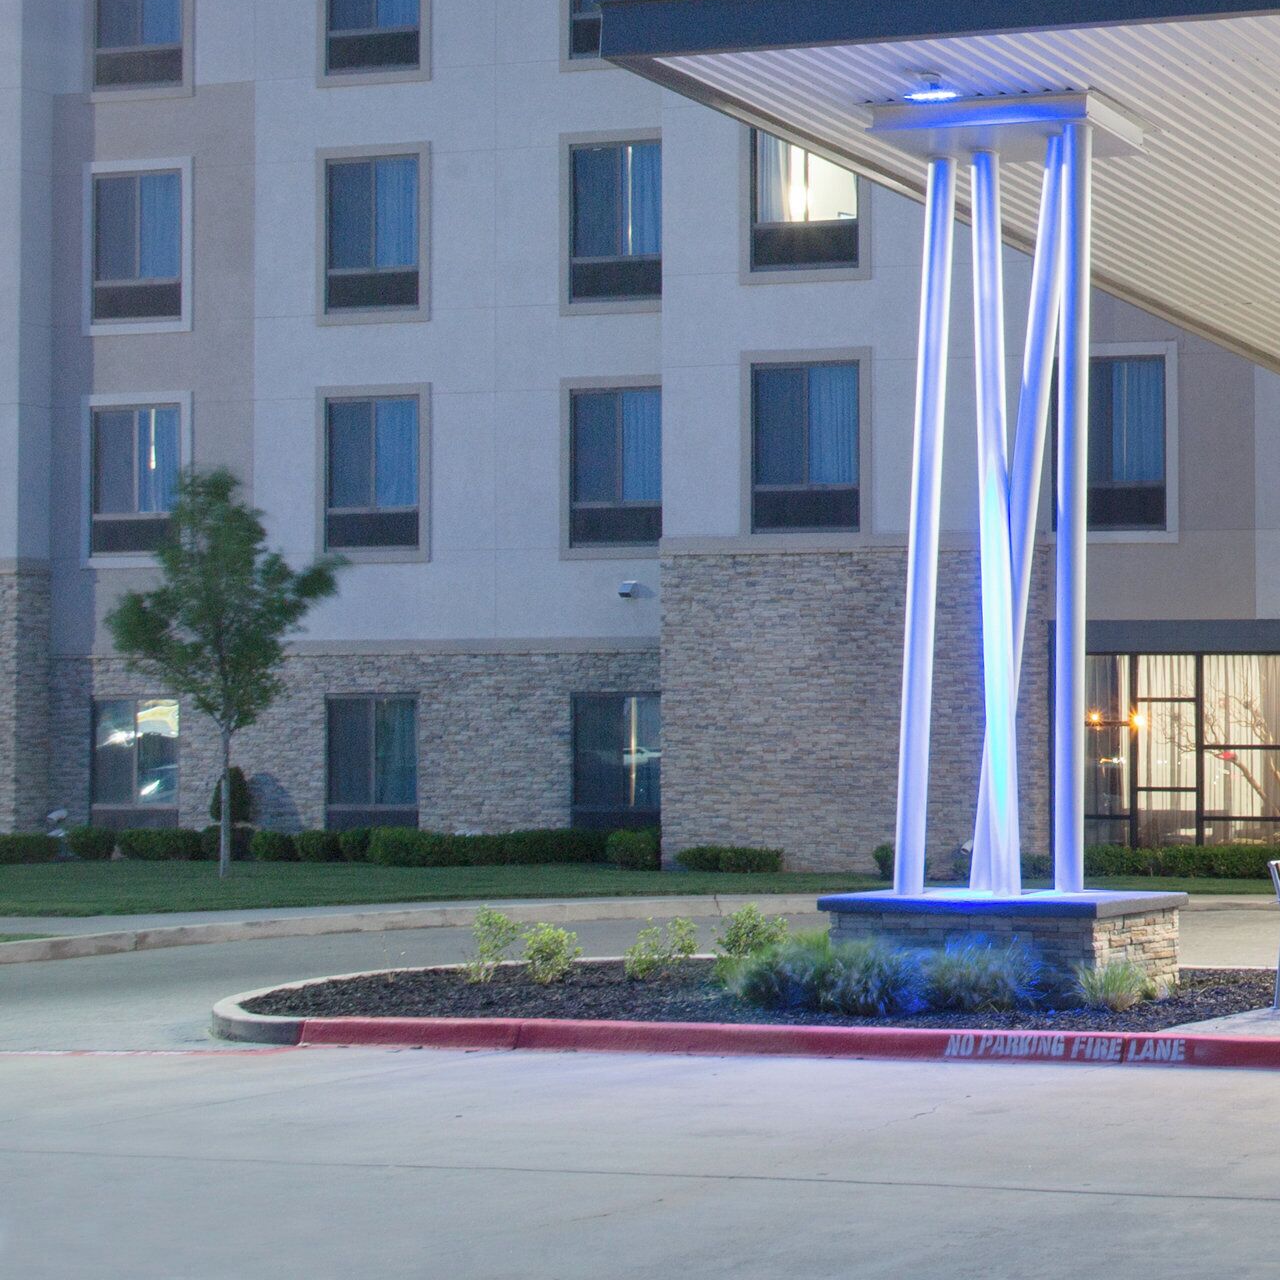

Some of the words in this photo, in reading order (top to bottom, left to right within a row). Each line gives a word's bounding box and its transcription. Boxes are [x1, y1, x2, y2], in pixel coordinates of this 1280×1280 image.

[944, 1034, 975, 1056] NO
[978, 1034, 1065, 1057] PARKING
[1071, 1036, 1123, 1059] FIRE
[1127, 1038, 1186, 1061] LANE
